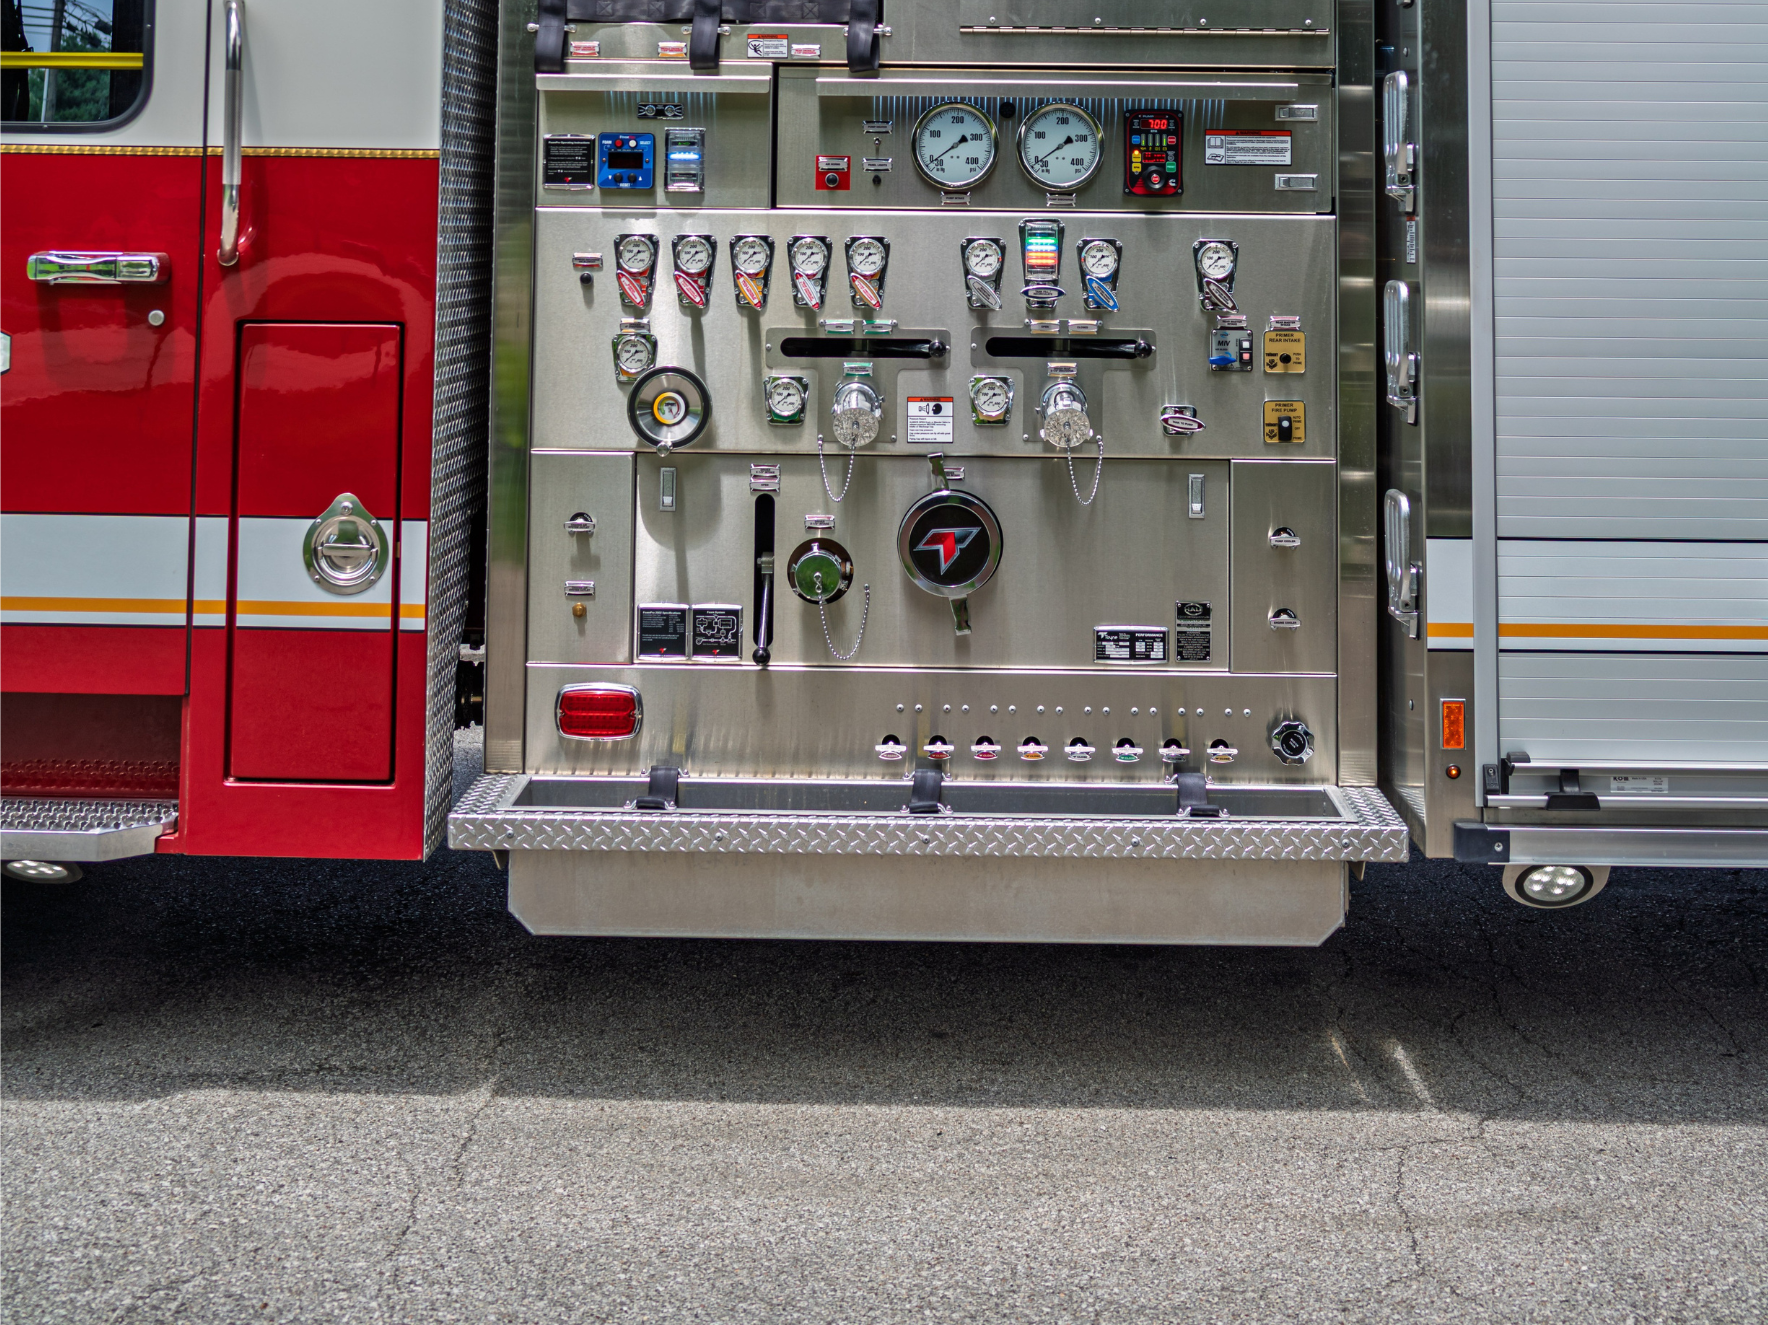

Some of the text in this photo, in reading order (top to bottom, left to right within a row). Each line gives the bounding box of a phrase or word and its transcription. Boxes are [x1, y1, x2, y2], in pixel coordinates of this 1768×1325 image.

[951, 116, 964, 124] 200
[1056, 117, 1069, 125] 200
[1148, 119, 1168, 129] 700
[1034, 131, 1046, 139] 100
[1074, 134, 1088, 142] 300
[965, 157, 979, 165] 400
[1070, 158, 1084, 166] 400
